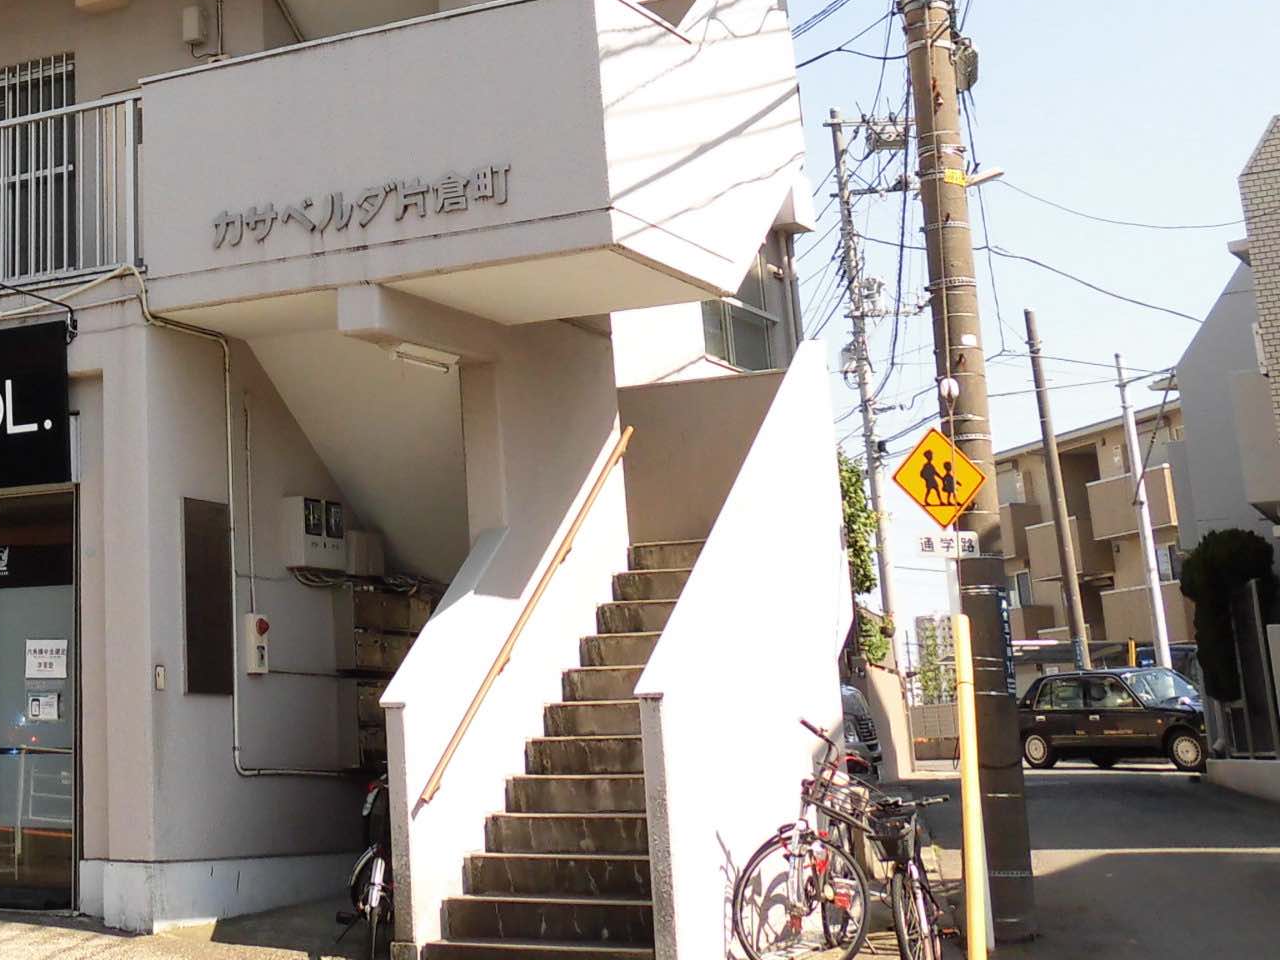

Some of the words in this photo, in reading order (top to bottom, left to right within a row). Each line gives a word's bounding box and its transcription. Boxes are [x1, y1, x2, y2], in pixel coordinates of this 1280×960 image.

[213, 162, 512, 249] カサベルダ片倉町
[920, 536, 975, 553] 通学路
